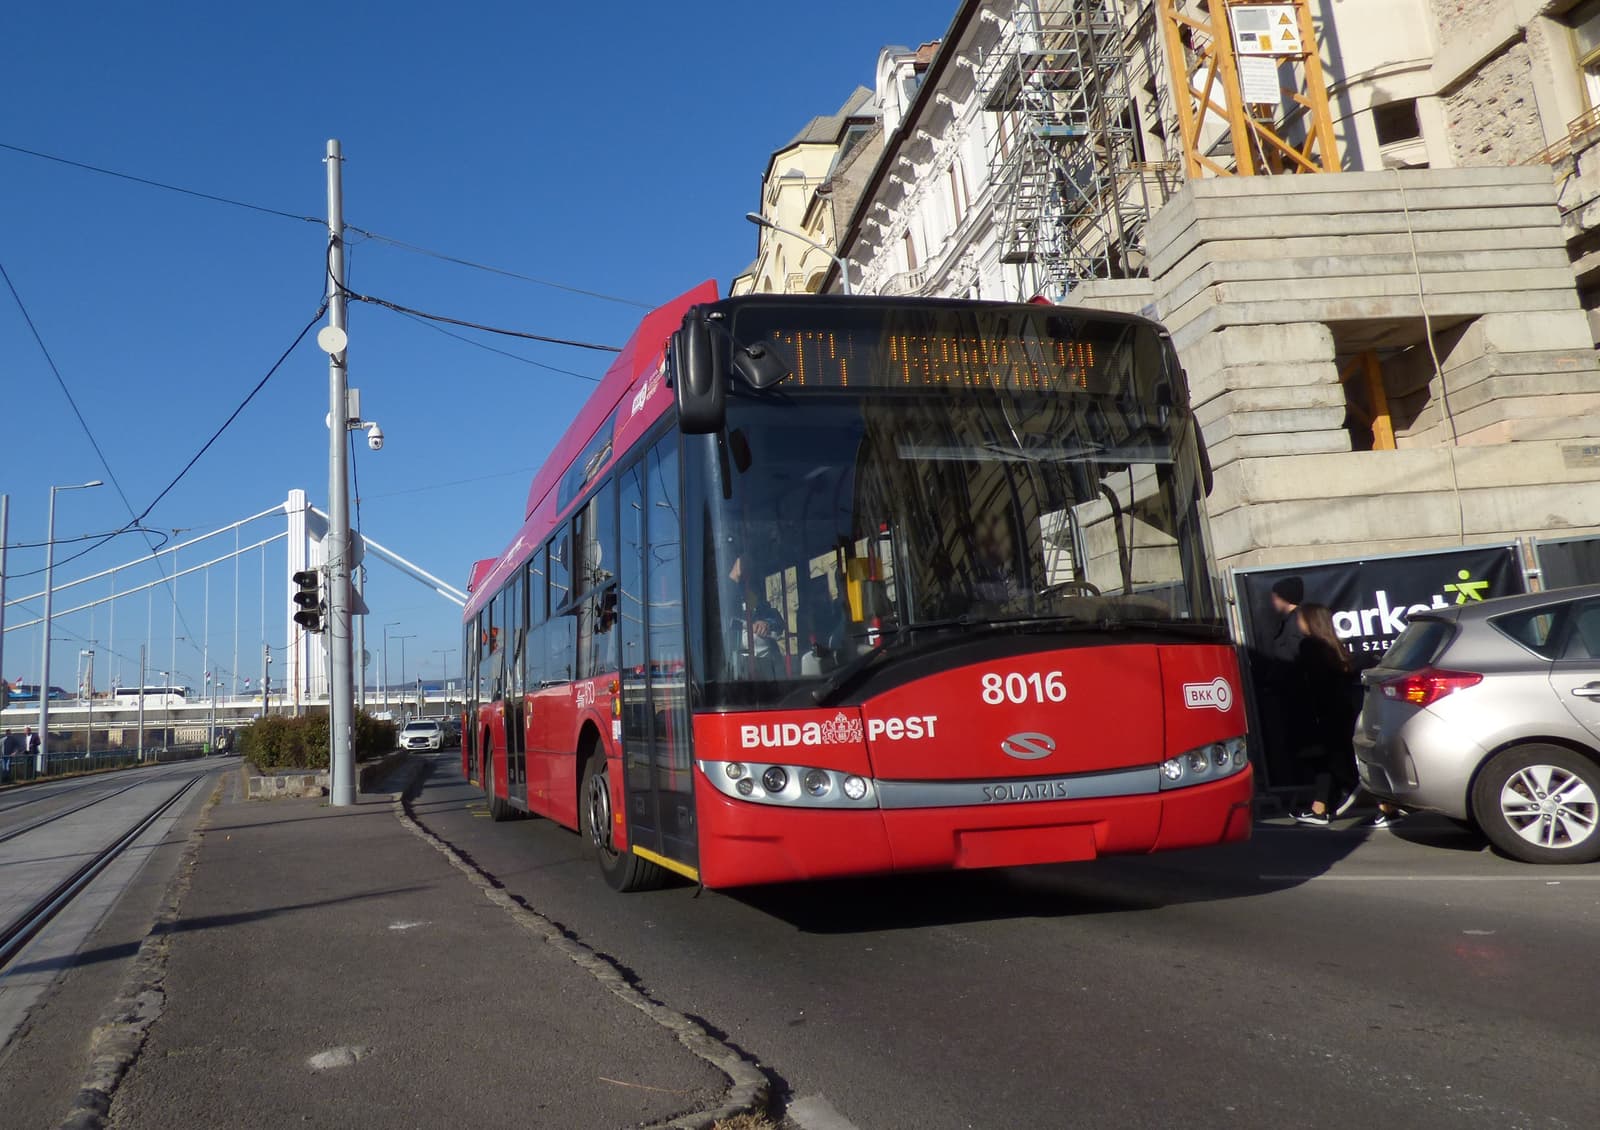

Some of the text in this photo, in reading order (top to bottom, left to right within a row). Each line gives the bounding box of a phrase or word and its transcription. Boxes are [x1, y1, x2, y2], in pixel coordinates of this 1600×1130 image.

[1362, 639, 1398, 652] SZE
[981, 671, 1067, 705] 8016
[1191, 690, 1213, 701] BKK
[983, 782, 1068, 802] SOLARIS
